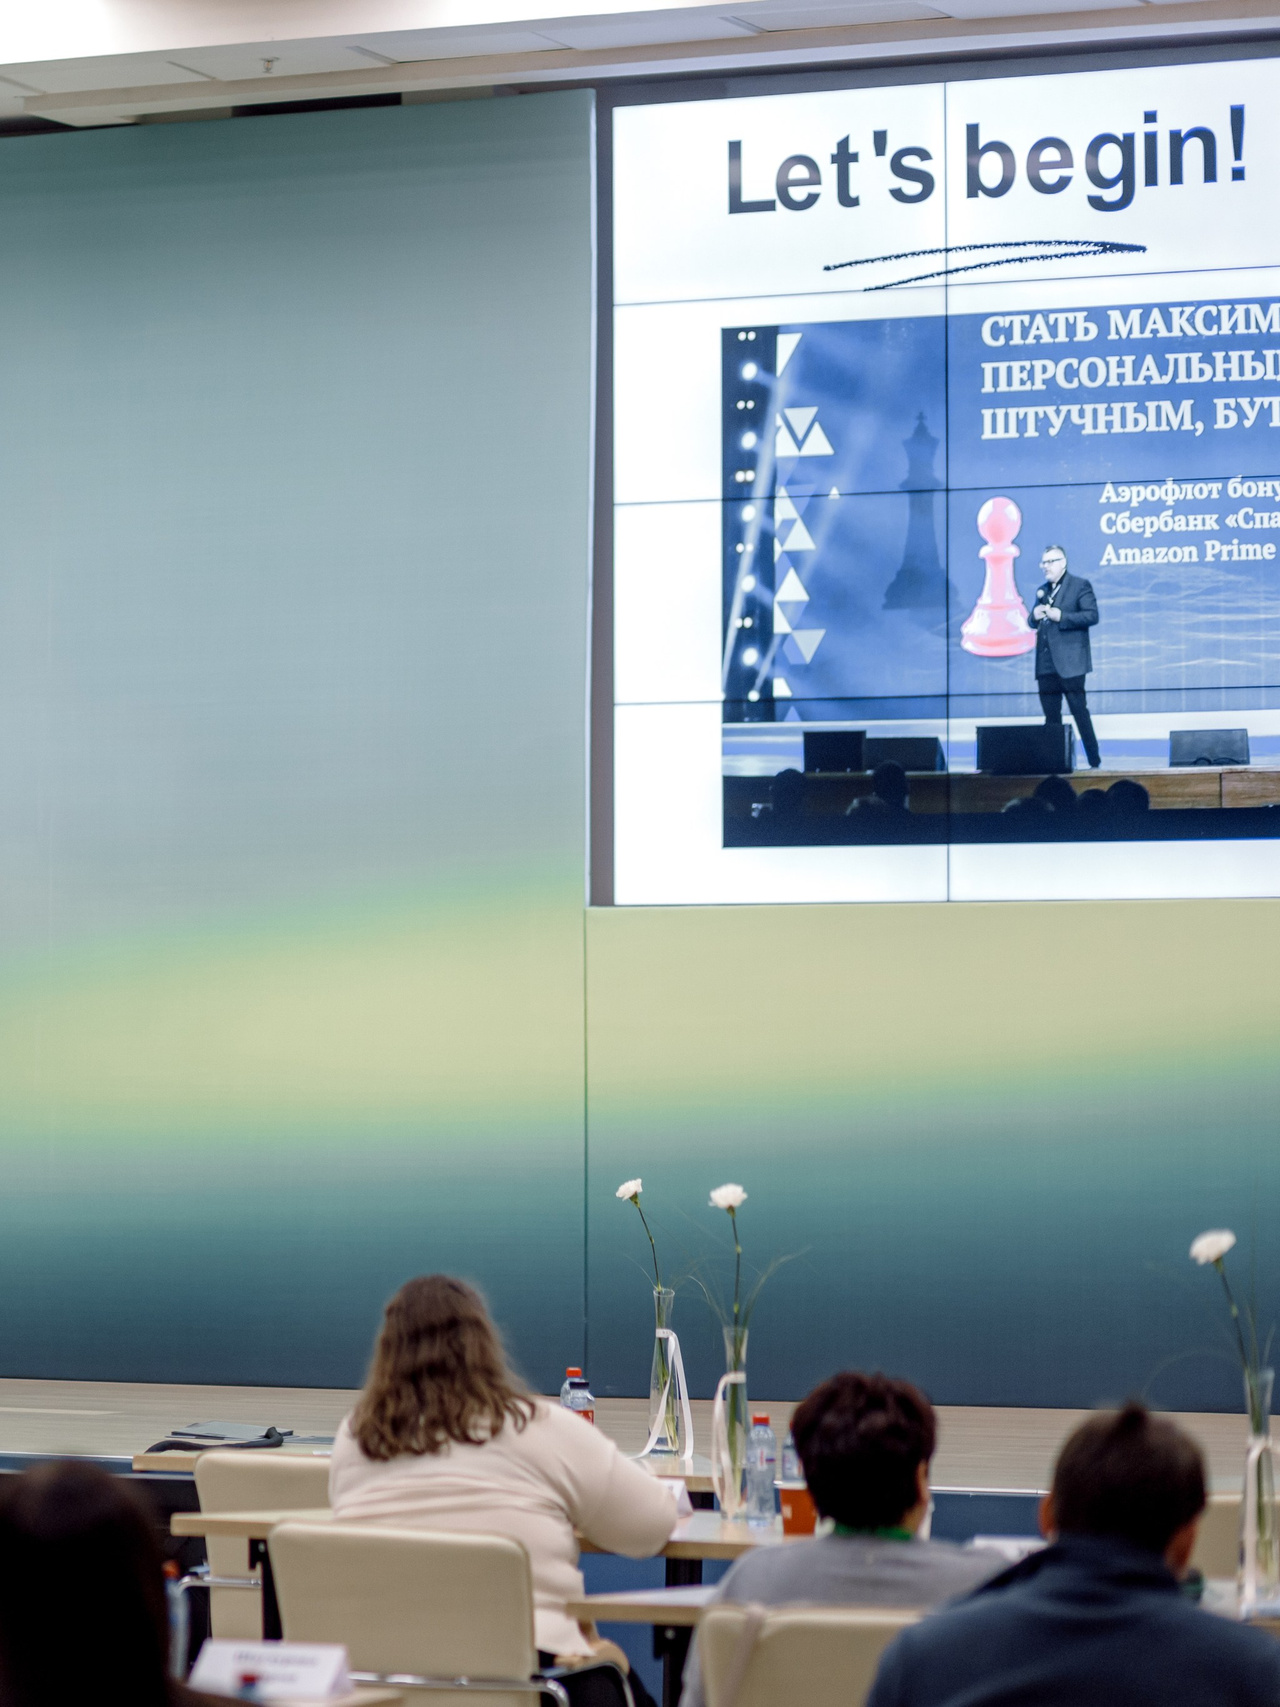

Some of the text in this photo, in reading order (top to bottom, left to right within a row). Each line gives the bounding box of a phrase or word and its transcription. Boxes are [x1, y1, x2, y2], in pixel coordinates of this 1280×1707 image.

[728, 104, 1246, 215] Let's begin!
[980, 303, 1280, 347] СТАТЬ МАКСИМ
[980, 349, 1280, 393] ПЕРСОНАЛЬНЫ
[980, 399, 1204, 440] ШТУЧНЫМ,
[1098, 477, 1223, 507] Аэрофлот
[1099, 509, 1220, 538] Сбербанк
[1099, 538, 1277, 566] Amazon Prime
